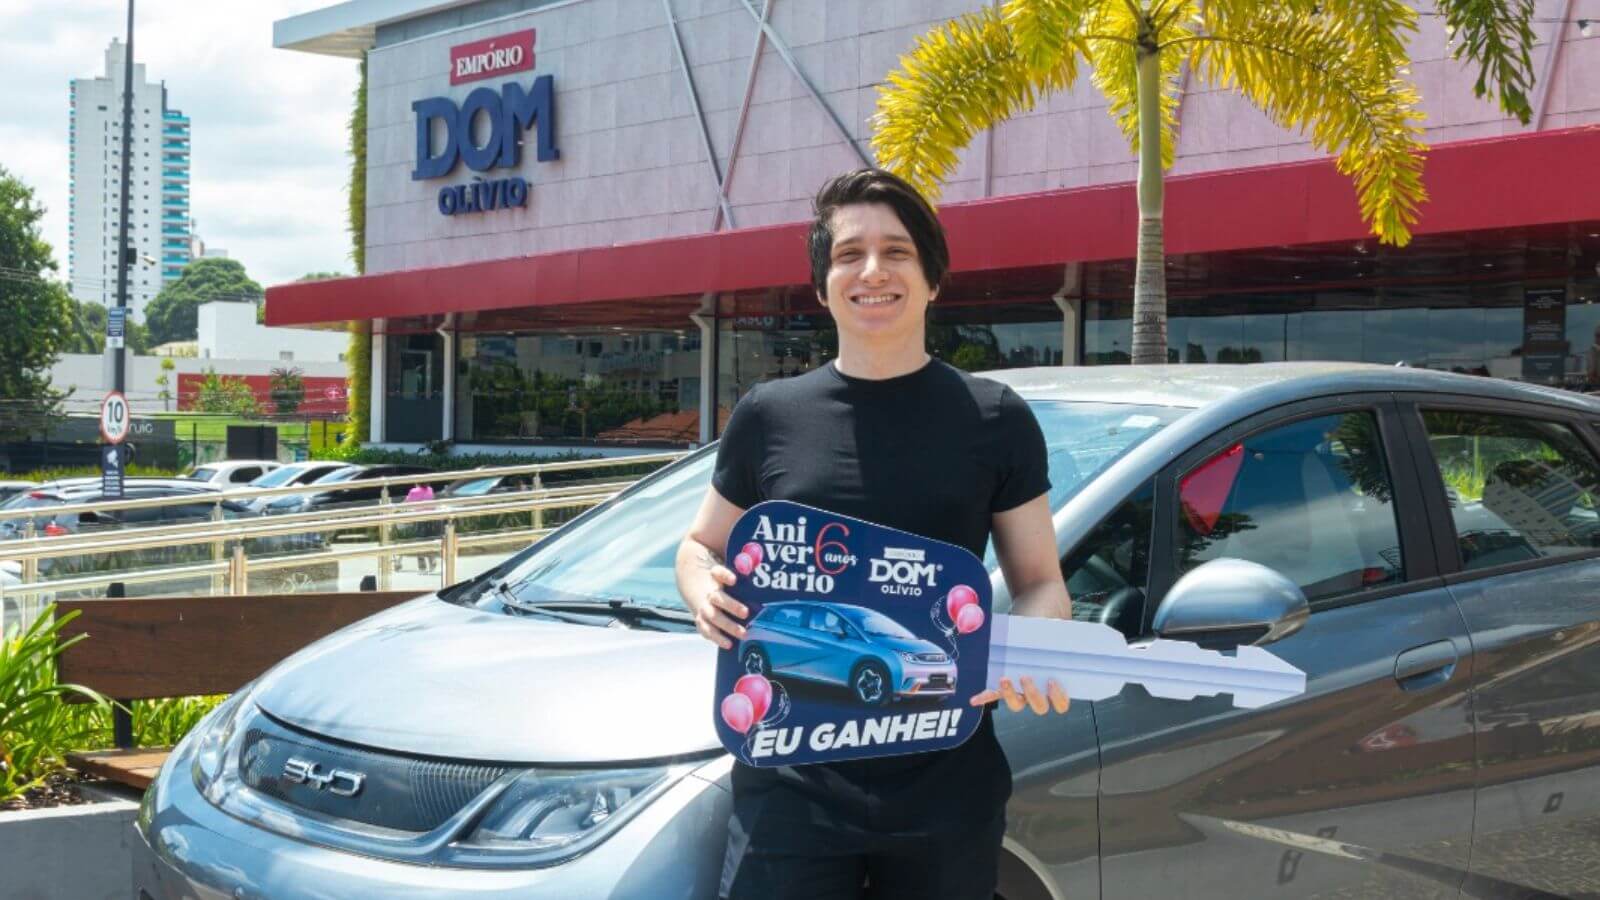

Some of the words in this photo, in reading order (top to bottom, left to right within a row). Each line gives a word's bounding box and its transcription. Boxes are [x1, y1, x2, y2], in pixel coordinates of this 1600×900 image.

[456, 43, 523, 77] EMPÓRIO
[412, 74, 561, 181] DOM
[107, 401, 124, 423] 10
[752, 515, 807, 543] Ani
[765, 543, 814, 564] ver
[815, 522, 850, 575] 6
[824, 552, 858, 566] anos
[752, 563, 834, 593] Sário
[869, 558, 937, 587] DOM
[751, 726, 803, 758] EU
[809, 708, 963, 751] GANHEI!
[282, 758, 367, 796] BYD
